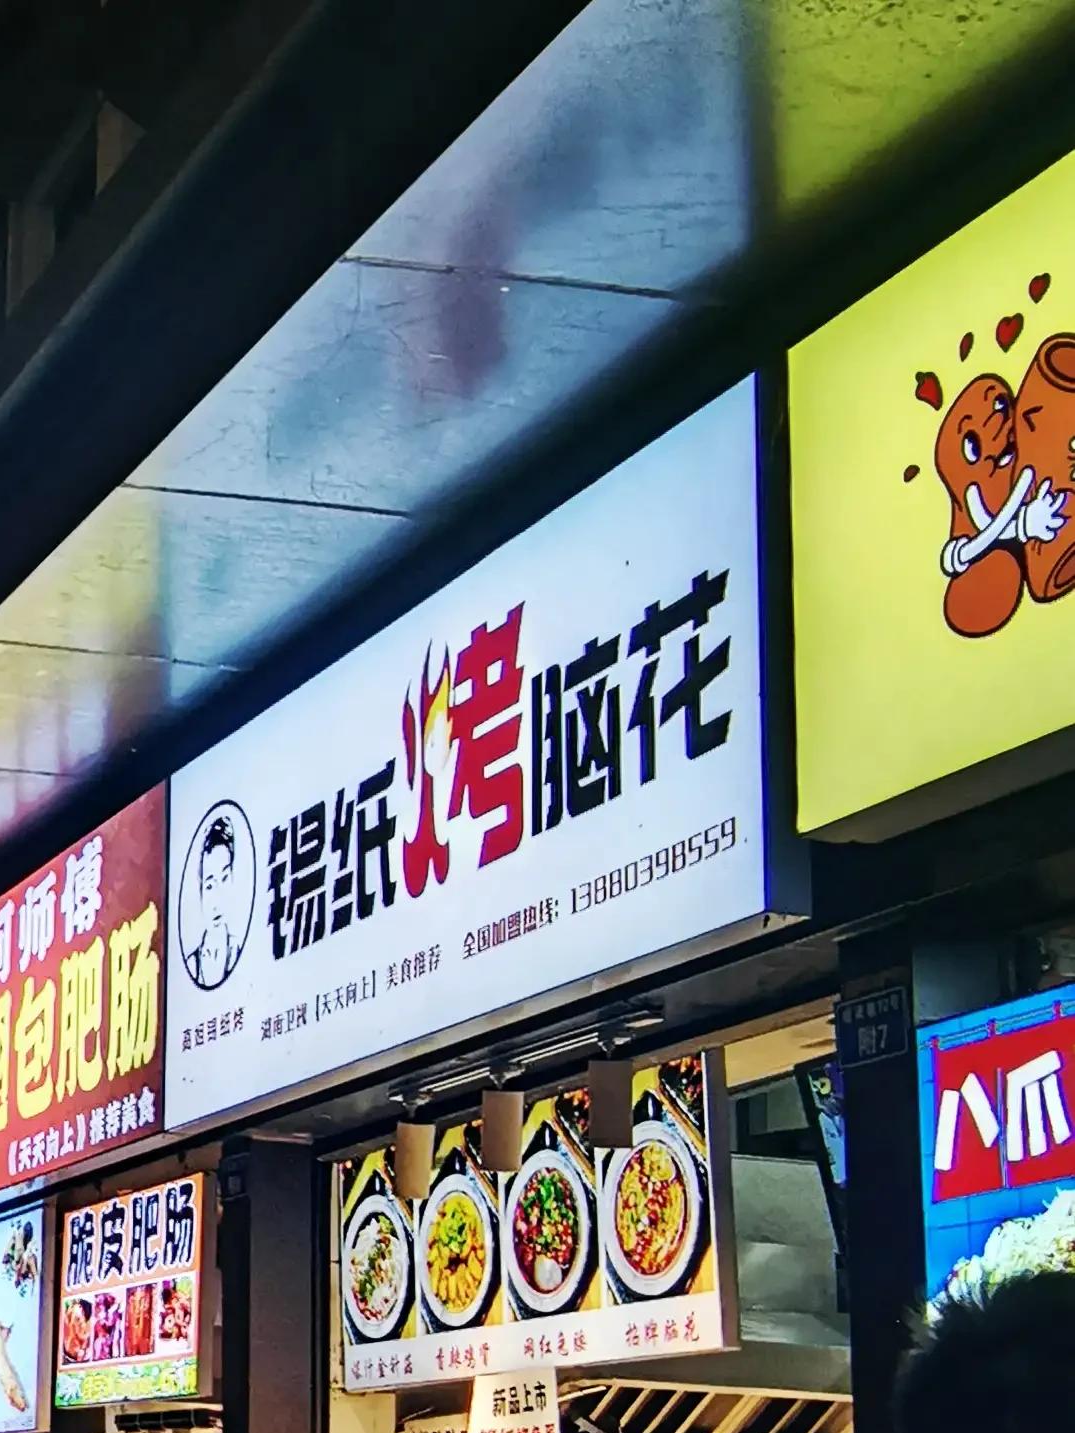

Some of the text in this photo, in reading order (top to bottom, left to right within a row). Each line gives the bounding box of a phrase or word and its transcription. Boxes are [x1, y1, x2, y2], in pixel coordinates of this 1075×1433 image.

[266, 567, 734, 960] 锡纸烤脑花
[66, 1181, 196, 1289] 脆皮肥肠
[492, 1380, 547, 1418] 新品上市
